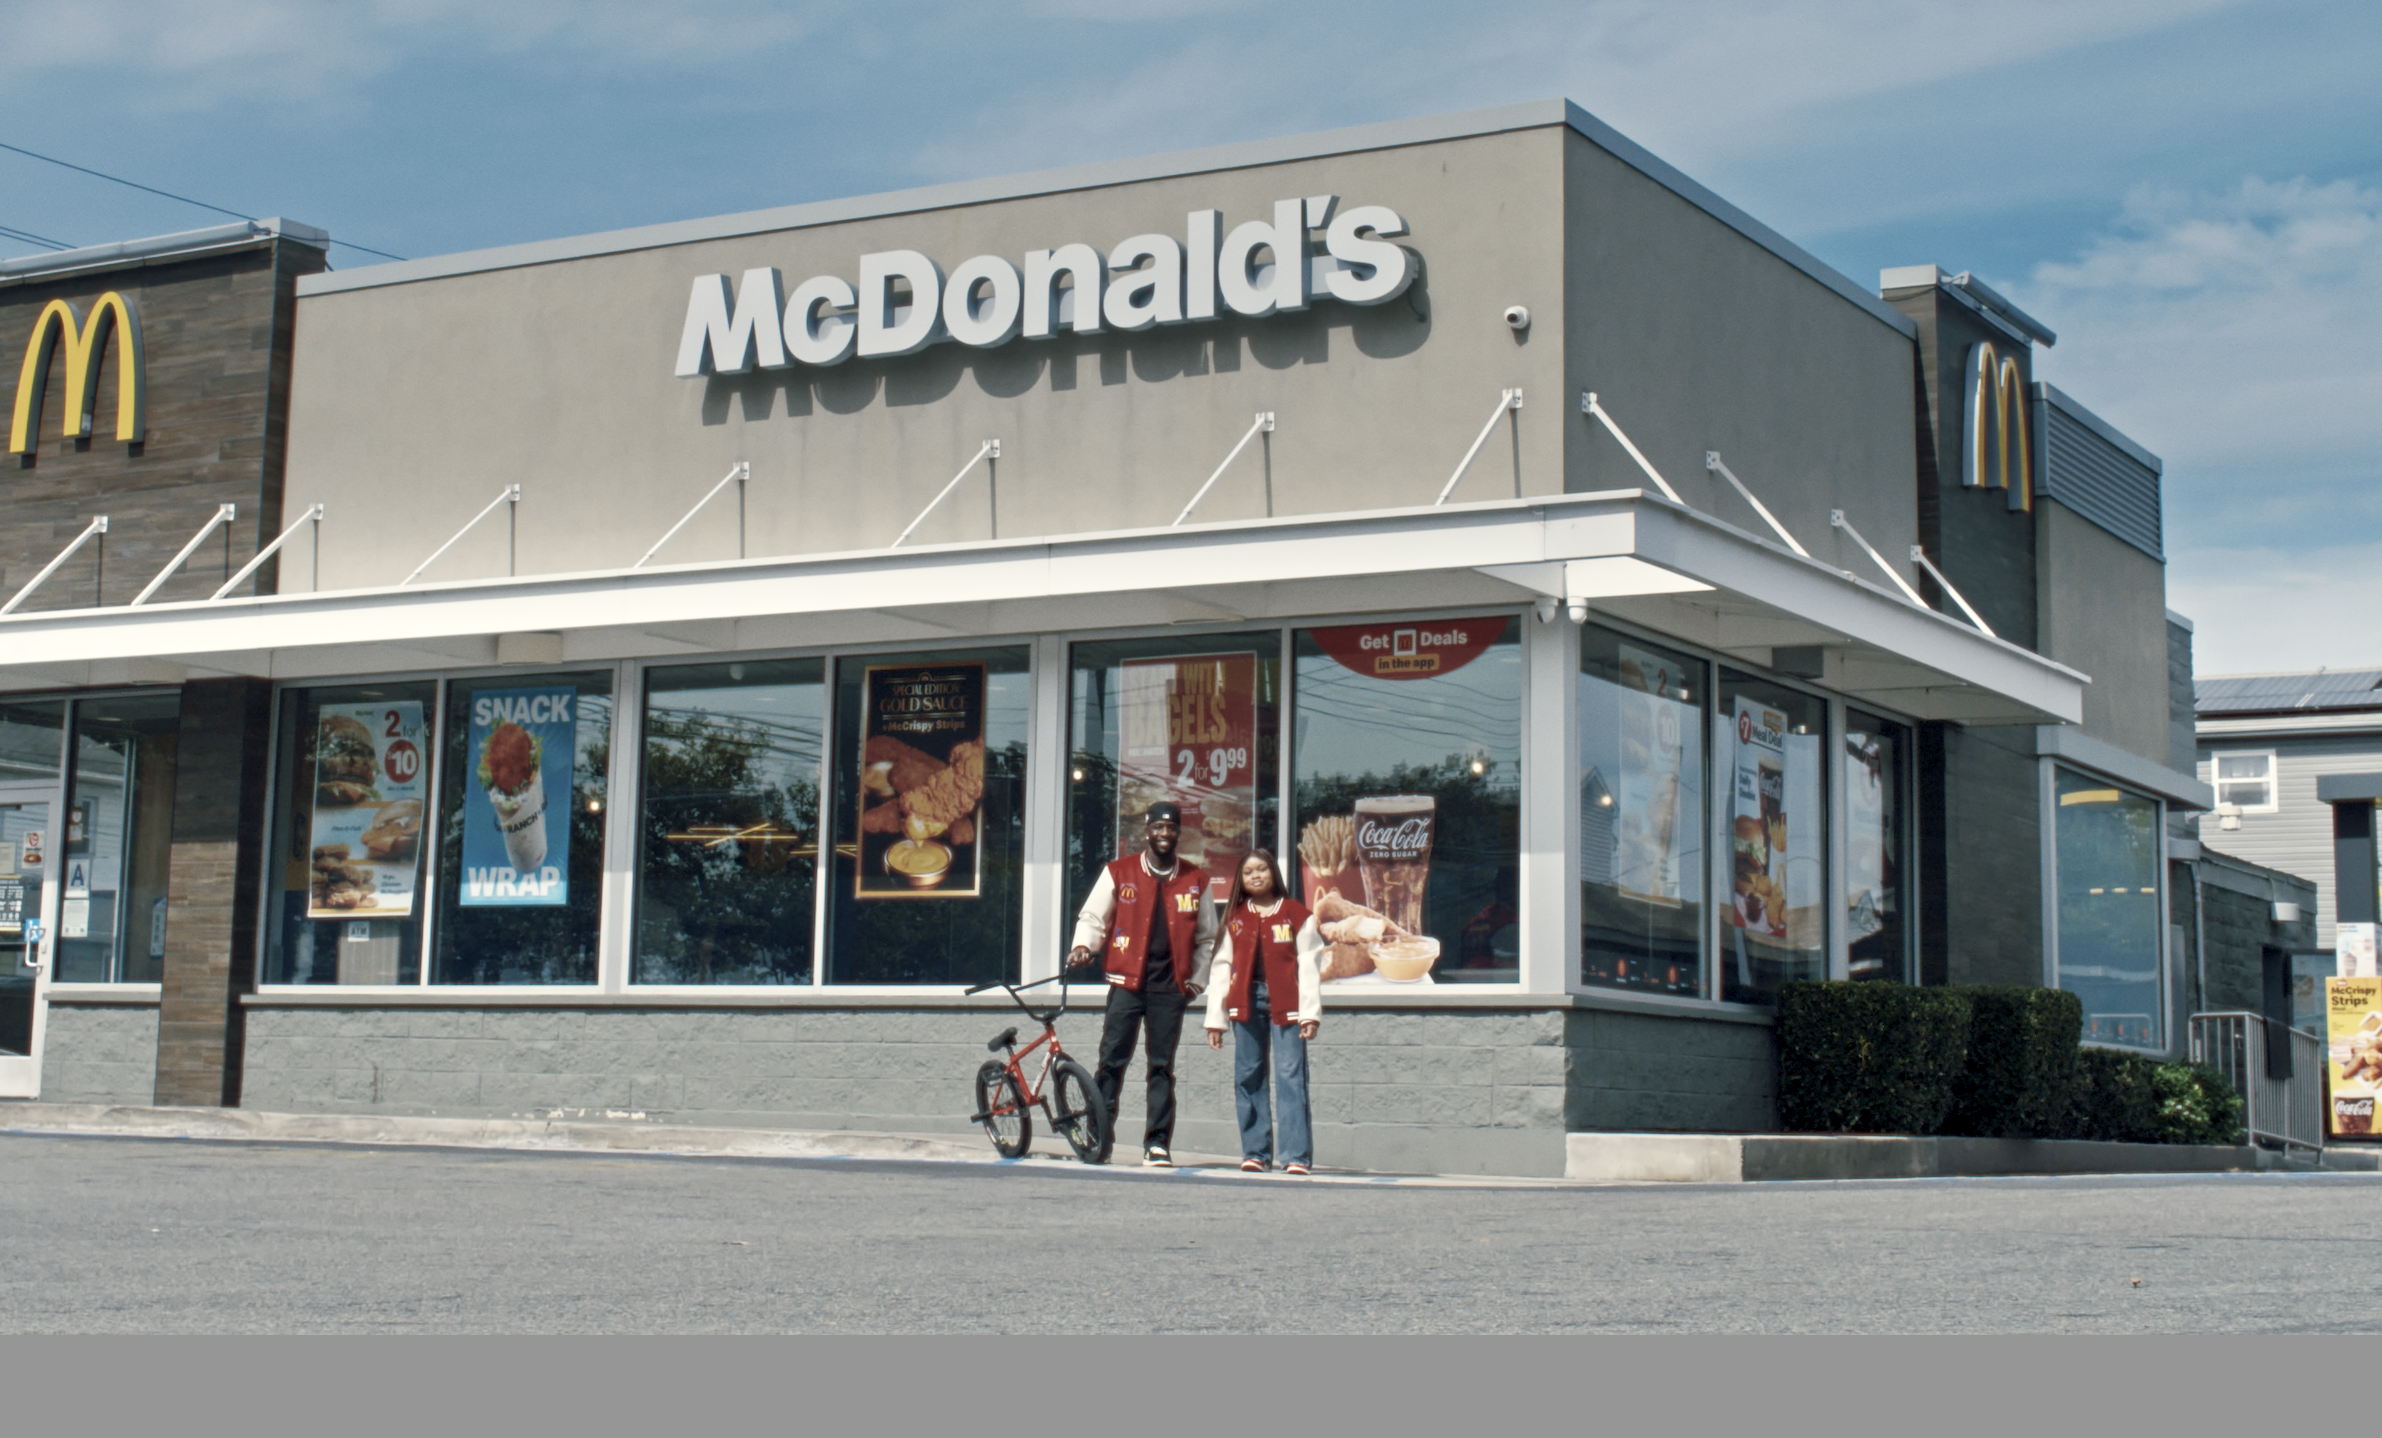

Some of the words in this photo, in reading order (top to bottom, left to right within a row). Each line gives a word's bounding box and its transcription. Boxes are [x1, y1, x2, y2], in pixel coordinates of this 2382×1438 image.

[675, 195, 1409, 377] McDonald's
[1360, 634, 1389, 649] Get
[1420, 630, 1467, 646] Deals
[1378, 658, 1391, 669] in
[1392, 657, 1411, 669] the
[1413, 656, 1435, 670] app
[893, 683, 923, 696] SPECIAL
[924, 682, 960, 695] EDITION
[474, 694, 572, 726] SNACK
[880, 697, 920, 712] GOLD
[922, 695, 966, 711] SAUCE
[385, 710, 401, 737] 2
[403, 725, 417, 738] for
[936, 718, 965, 731] Strips
[1129, 694, 1227, 747] BAGELS
[1177, 749, 1194, 786] 2
[1195, 764, 1208, 780] for
[507, 812, 539, 834] RANCH
[1358, 817, 1432, 850] Coca-Cola
[1391, 850, 1418, 858] SUGAR
[70, 863, 85, 887] A
[468, 866, 561, 898] WRAP
[2331, 985, 2376, 996] McCrispy
[2331, 995, 2368, 1008] Strips
[2335, 1099, 2375, 1116] Coca-Cola
